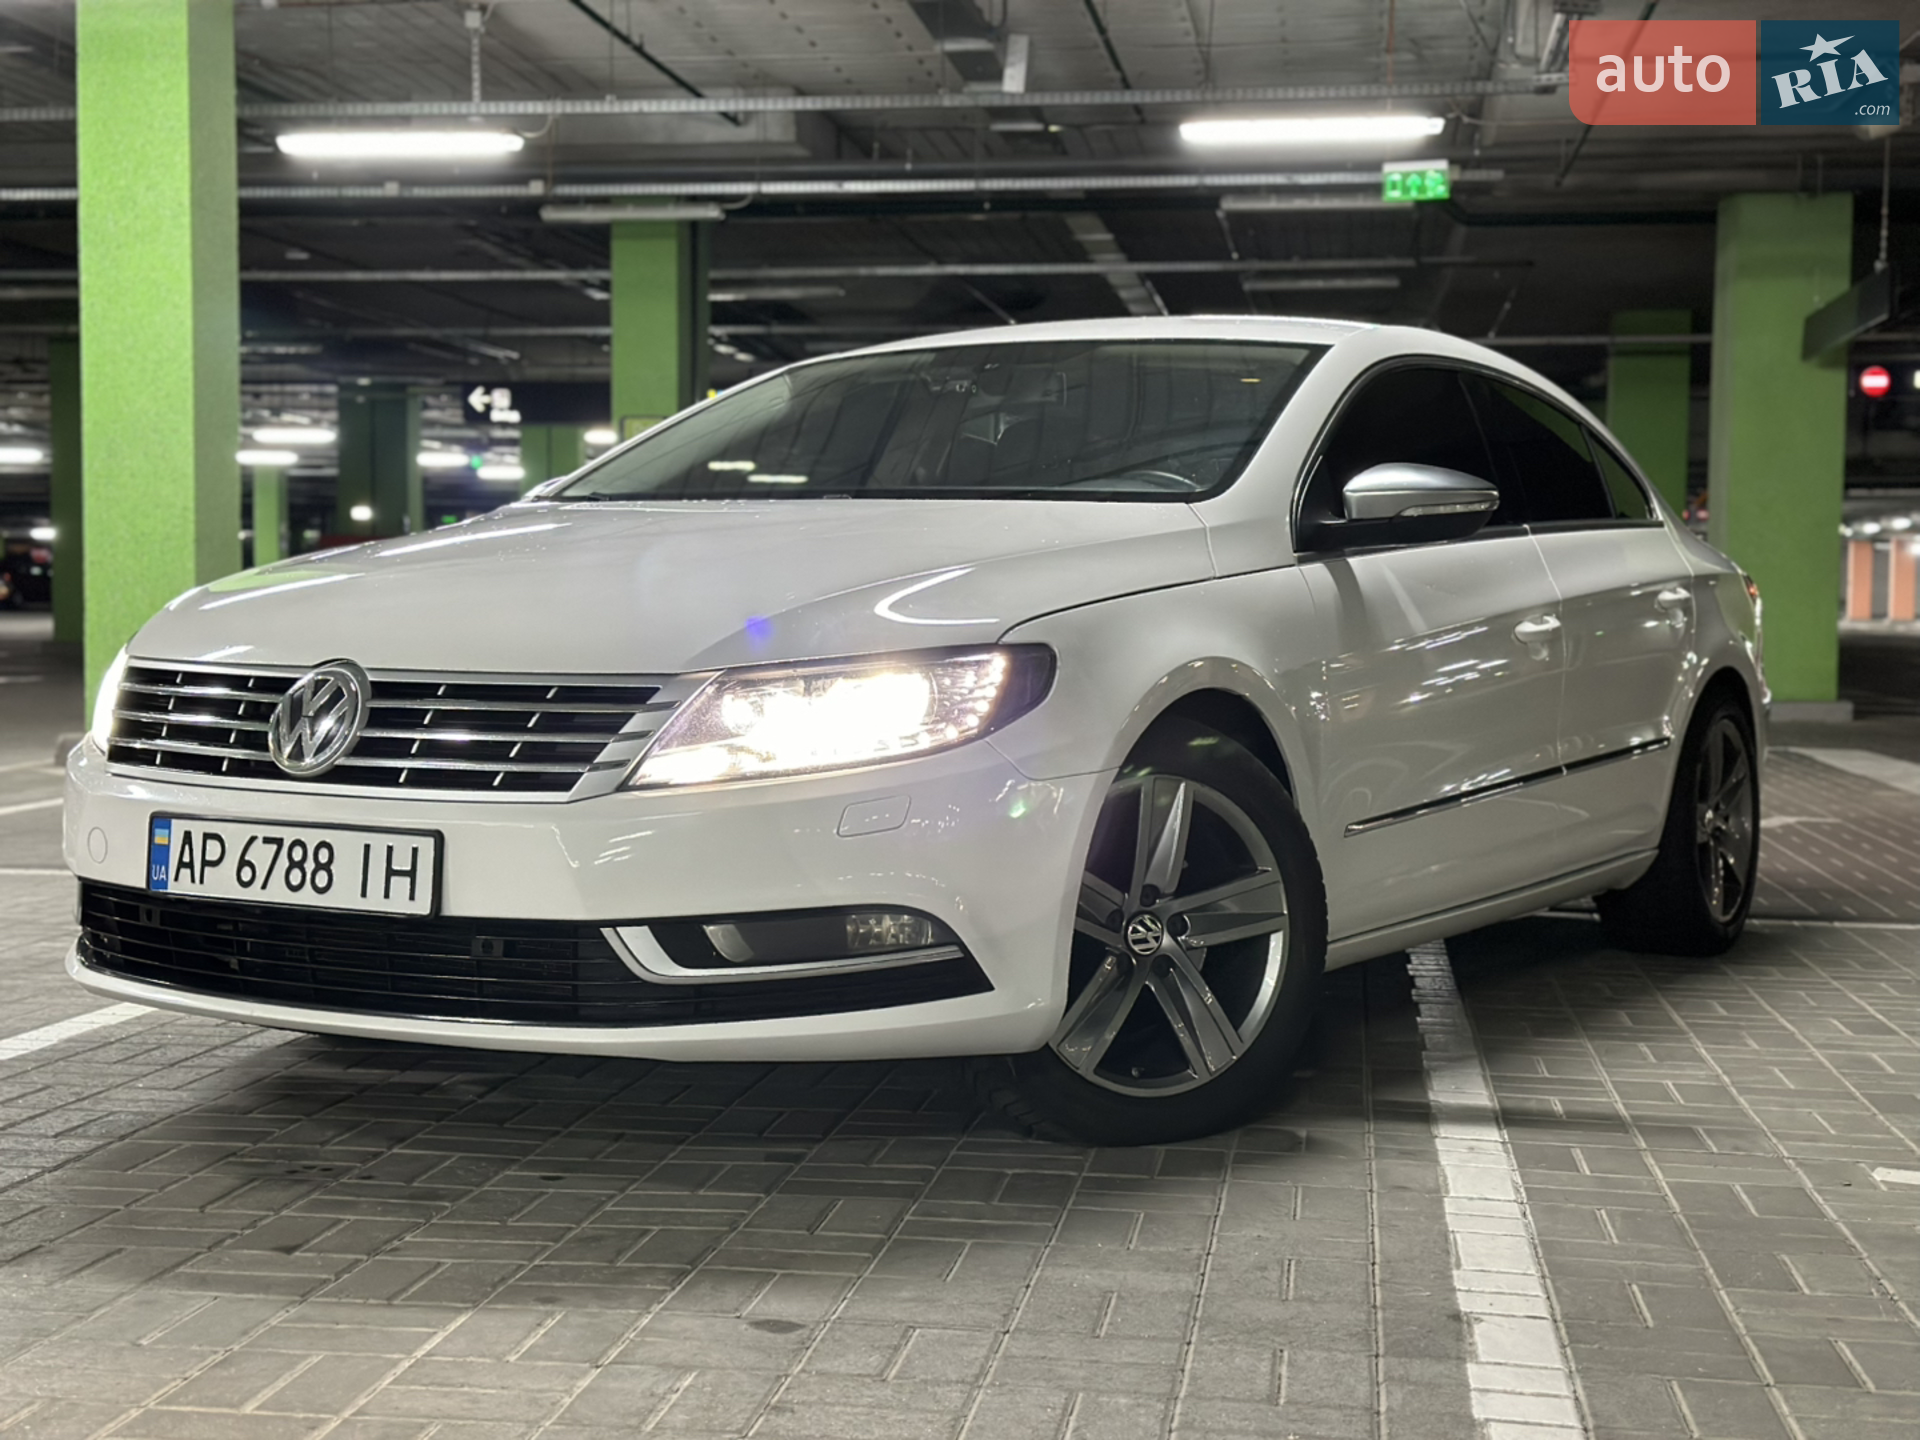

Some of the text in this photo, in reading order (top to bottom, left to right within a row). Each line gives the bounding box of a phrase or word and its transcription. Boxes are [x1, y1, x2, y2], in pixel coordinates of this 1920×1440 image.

[152, 864, 168, 881] UA
[173, 830, 418, 901] AP 6788 IH
